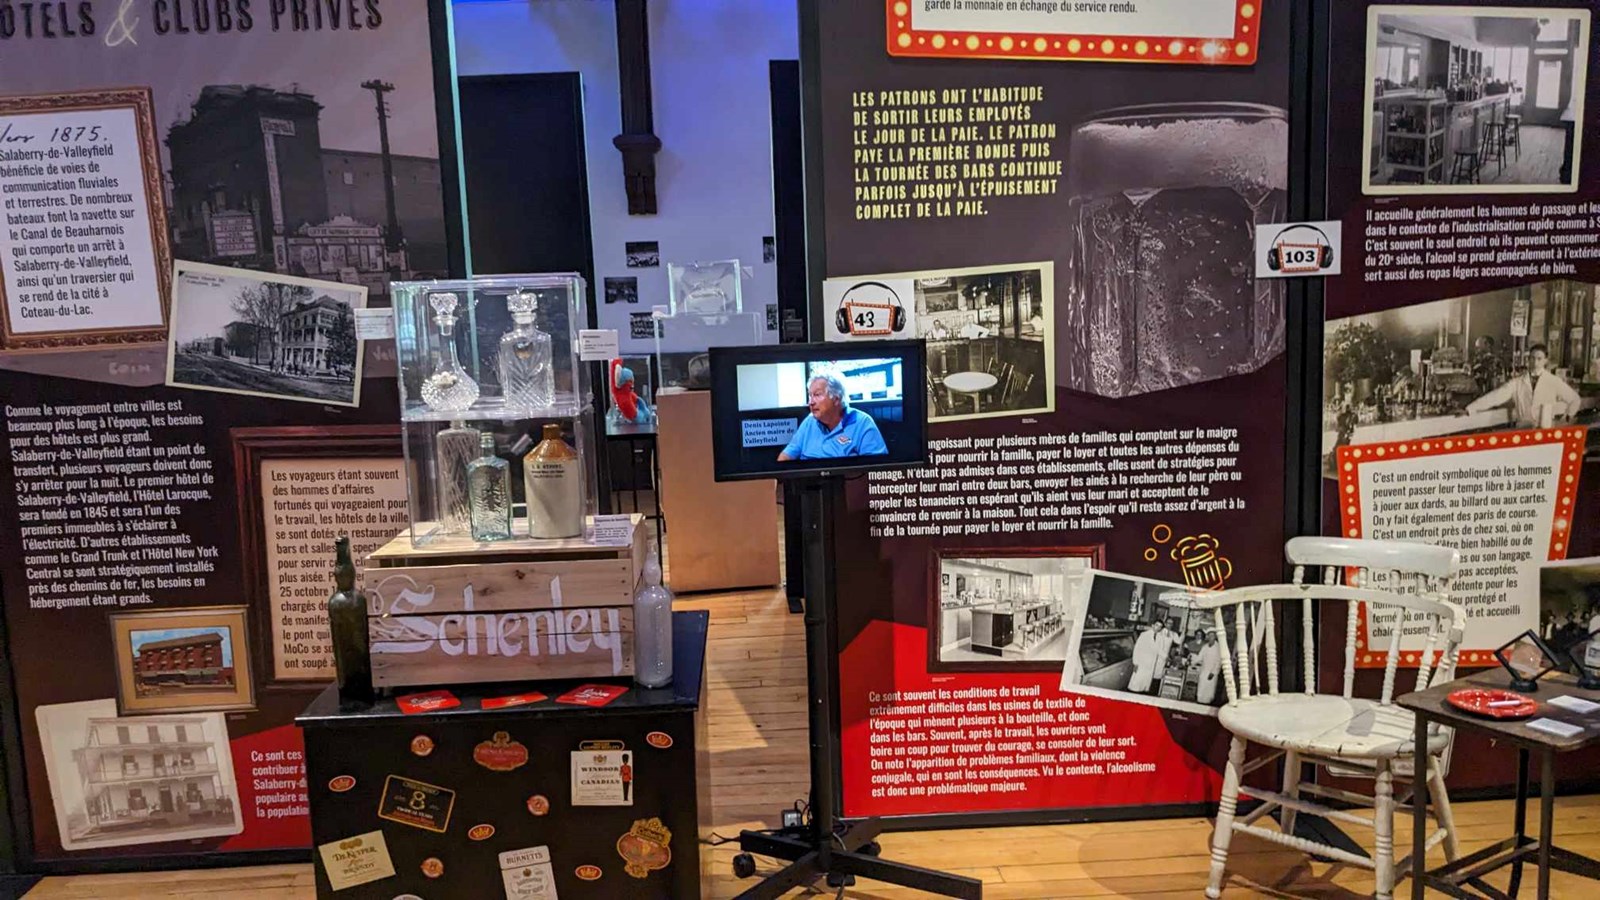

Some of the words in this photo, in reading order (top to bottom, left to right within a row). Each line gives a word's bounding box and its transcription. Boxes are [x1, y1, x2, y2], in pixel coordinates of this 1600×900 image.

[925, 0, 950, 12] garde
[954, 0, 962, 9] la
[965, 0, 1004, 10] monnaie
[1006, 2, 1017, 11] en
[1020, 0, 1058, 13] échange
[1060, 0, 1072, 11] du
[1074, 1, 1106, 12] service
[1109, 1, 1137, 13] rendu.
[105, 0, 140, 47] &
[153, 0, 253, 35] CLUBS
[853, 92, 874, 107] LES
[880, 90, 936, 106] PATRONS
[942, 89, 965, 104] ONT
[972, 86, 1042, 103] L'HABITUDE
[50, 126, 108, 142] 1875.
[854, 148, 882, 163] PAYE
[889, 148, 903, 162] LA
[909, 143, 969, 161] PREMIÈRE
[976, 144, 1015, 159] RONDE
[1022, 142, 1050, 158] PUIS
[3, 179, 76, 193] communication
[78, 176, 118, 189] fluviales
[856, 185, 906, 201] PARFOIS
[912, 180, 964, 201] JUSQU'À
[970, 177, 1056, 196] L'ÉPUISEMENT
[856, 204, 910, 219] COMPLET
[917, 203, 930, 217] DE
[937, 202, 950, 216] LA
[957, 201, 988, 215] PAIE.
[1366, 210, 1372, 221] Il
[1374, 208, 1414, 221] accueille
[1416, 206, 1475, 222] généralement
[1477, 205, 1490, 217] les
[1492, 204, 1528, 216] hommes
[1530, 203, 1540, 215] de
[1542, 205, 1576, 217] passage
[1578, 203, 1587, 213] et
[10, 229, 18, 240] le
[21, 227, 48, 240] Canal
[51, 226, 62, 238] de
[65, 224, 124, 238] Beauharnois
[1286, 250, 1315, 263] 103
[17, 276, 39, 287] ainsi
[42, 274, 68, 288] qu'un
[71, 271, 116, 284] traversier
[119, 270, 134, 283] qui
[1365, 270, 1382, 281] sert
[1384, 268, 1407, 280] aussi
[1409, 268, 1424, 279] des
[1426, 269, 1450, 281] repas
[1452, 266, 1479, 280] légers
[1481, 263, 1538, 279] accompagnés
[1540, 263, 1551, 274] de
[1553, 262, 1576, 274] bière.
[21, 303, 93, 318] Coteau-du-Lac.
[854, 312, 874, 328] 43
[5, 404, 41, 417] Comme
[43, 404, 52, 416] le
[54, 402, 110, 417] voyagement
[113, 402, 138, 413] entre
[140, 400, 165, 411] villes
[168, 400, 182, 410] est
[12, 446, 124, 463] Salaberry-de-Valleyfield
[126, 445, 150, 457] étant
[153, 447, 165, 456] un
[167, 444, 191, 457] point
[193, 443, 205, 454] de
[271, 470, 287, 481] Les
[289, 472, 335, 482] voyageurs
[338, 469, 361, 480] étant
[364, 470, 398, 480] souvent
[1373, 472, 1394, 483] C'est
[1410, 470, 1439, 481] endroit
[1442, 467, 1489, 481] symbolique
[1491, 466, 1502, 477] où
[1504, 466, 1516, 477] les
[1518, 464, 1552, 476] hommes
[17, 490, 132, 508] Salaberry-de-Valleyfield,
[134, 489, 164, 501] l'Hôtel
[166, 487, 210, 502] Larocque,
[274, 499, 312, 510] fortunés
[314, 500, 328, 512] qui
[331, 499, 385, 511] voyageaient
[388, 500, 408, 510] pour
[870, 527, 881, 536] fin
[884, 525, 894, 536] de
[896, 525, 905, 535] la
[907, 523, 940, 535] tournée
[943, 525, 962, 536] pour
[965, 524, 989, 535] payer
[992, 521, 1000, 532] le
[1002, 520, 1024, 533] loyer
[1026, 520, 1035, 531] et
[1038, 519, 1068, 530] nourrir
[1070, 518, 1078, 529] la
[1081, 517, 1113, 528] famille.
[1373, 515, 1384, 526] On
[1387, 517, 1392, 527] y
[1394, 514, 1408, 524] fait
[1411, 512, 1454, 526] également
[1457, 511, 1471, 521] des
[1474, 510, 1494, 522] paris
[1496, 509, 1506, 519] de
[1508, 509, 1538, 519] course.
[30, 596, 90, 610] hébergement
[92, 594, 117, 605] étant
[119, 592, 152, 606] grands.
[366, 574, 622, 676] Schenley
[869, 692, 880, 702] Ce
[883, 691, 901, 701] sont
[903, 690, 936, 701] souvent
[938, 688, 951, 699] les
[953, 687, 997, 698] conditions
[999, 686, 1010, 697] de
[1012, 685, 1040, 696] travail
[251, 750, 263, 762] Ce
[265, 750, 284, 761] sont
[287, 752, 302, 760] ces
[871, 759, 883, 770] On
[885, 759, 904, 769] note
[906, 756, 955, 770] l'apparition
[956, 755, 967, 766] de
[969, 754, 1014, 770] problèmes
[1016, 750, 1056, 764] familiaux,
[1059, 751, 1078, 762] dont
[1080, 751, 1089, 761] la
[1090, 749, 1125, 760] violence
[252, 764, 298, 776] contribuer
[872, 787, 885, 797] est
[887, 785, 908, 796] donc
[910, 786, 925, 795] une
[927, 782, 988, 796] problématique
[990, 780, 1026, 793] majeure.
[256, 792, 297, 806] populaire
[409, 790, 426, 810] 8
